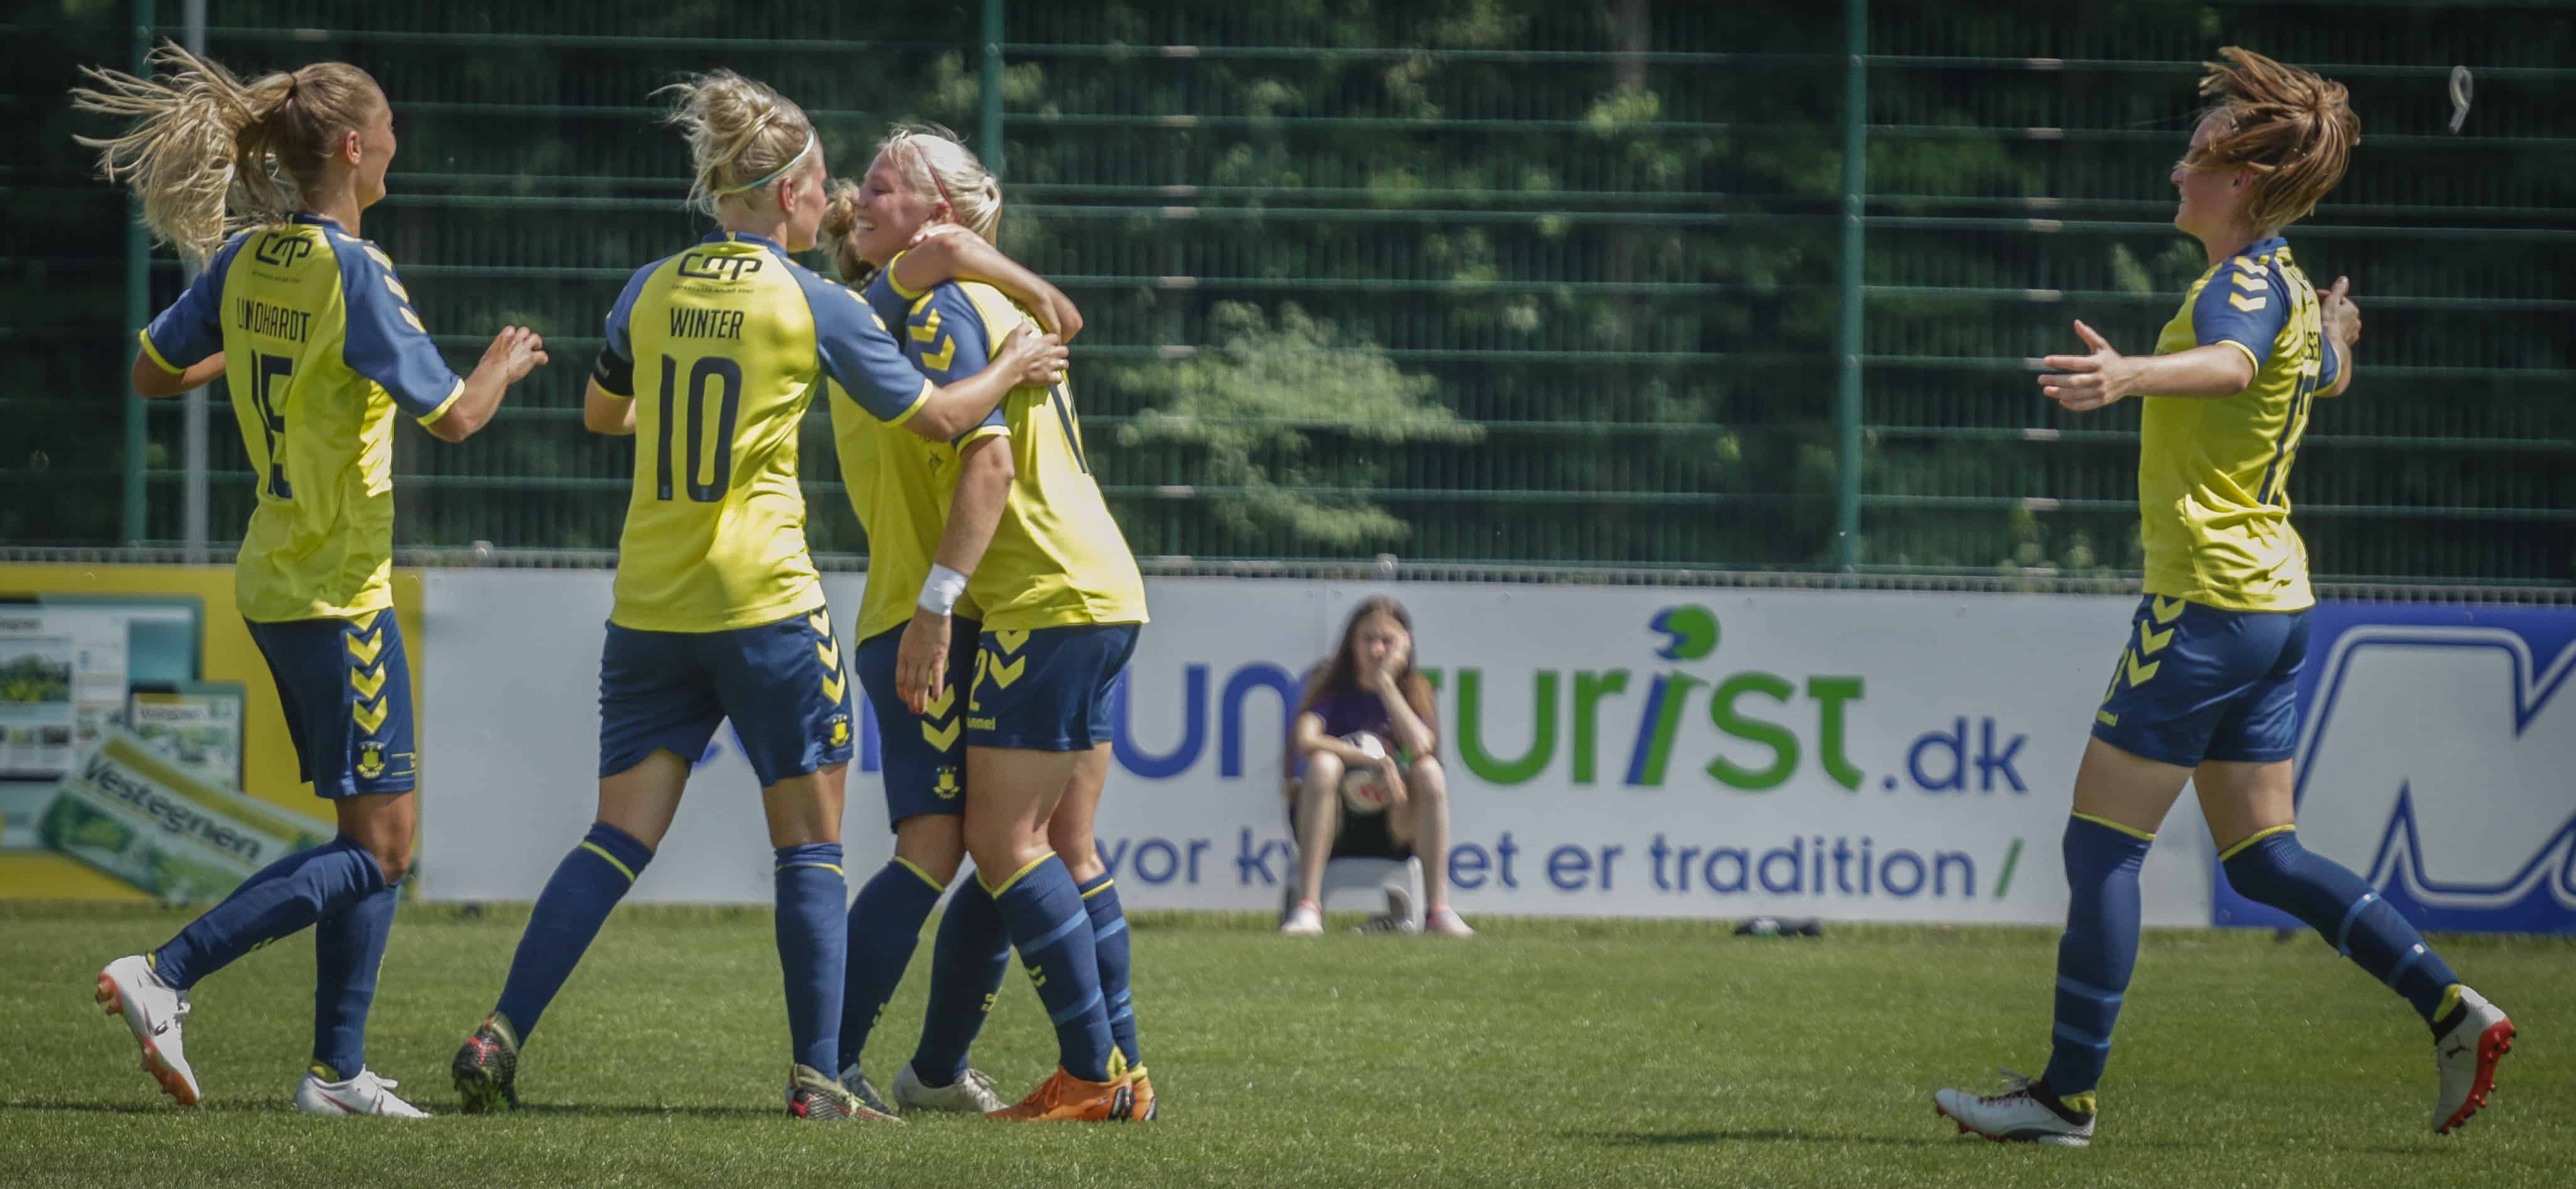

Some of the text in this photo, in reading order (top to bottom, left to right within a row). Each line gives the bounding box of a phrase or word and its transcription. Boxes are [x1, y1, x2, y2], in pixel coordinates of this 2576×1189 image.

[669, 307, 745, 340] WINTER
[252, 349, 294, 500] 15
[657, 354, 743, 502] 10
[84, 753, 262, 861] Vestegnen
[1095, 835, 1211, 885] vor
[1545, 843, 1625, 890] er
[1650, 833, 1977, 898] tradition
